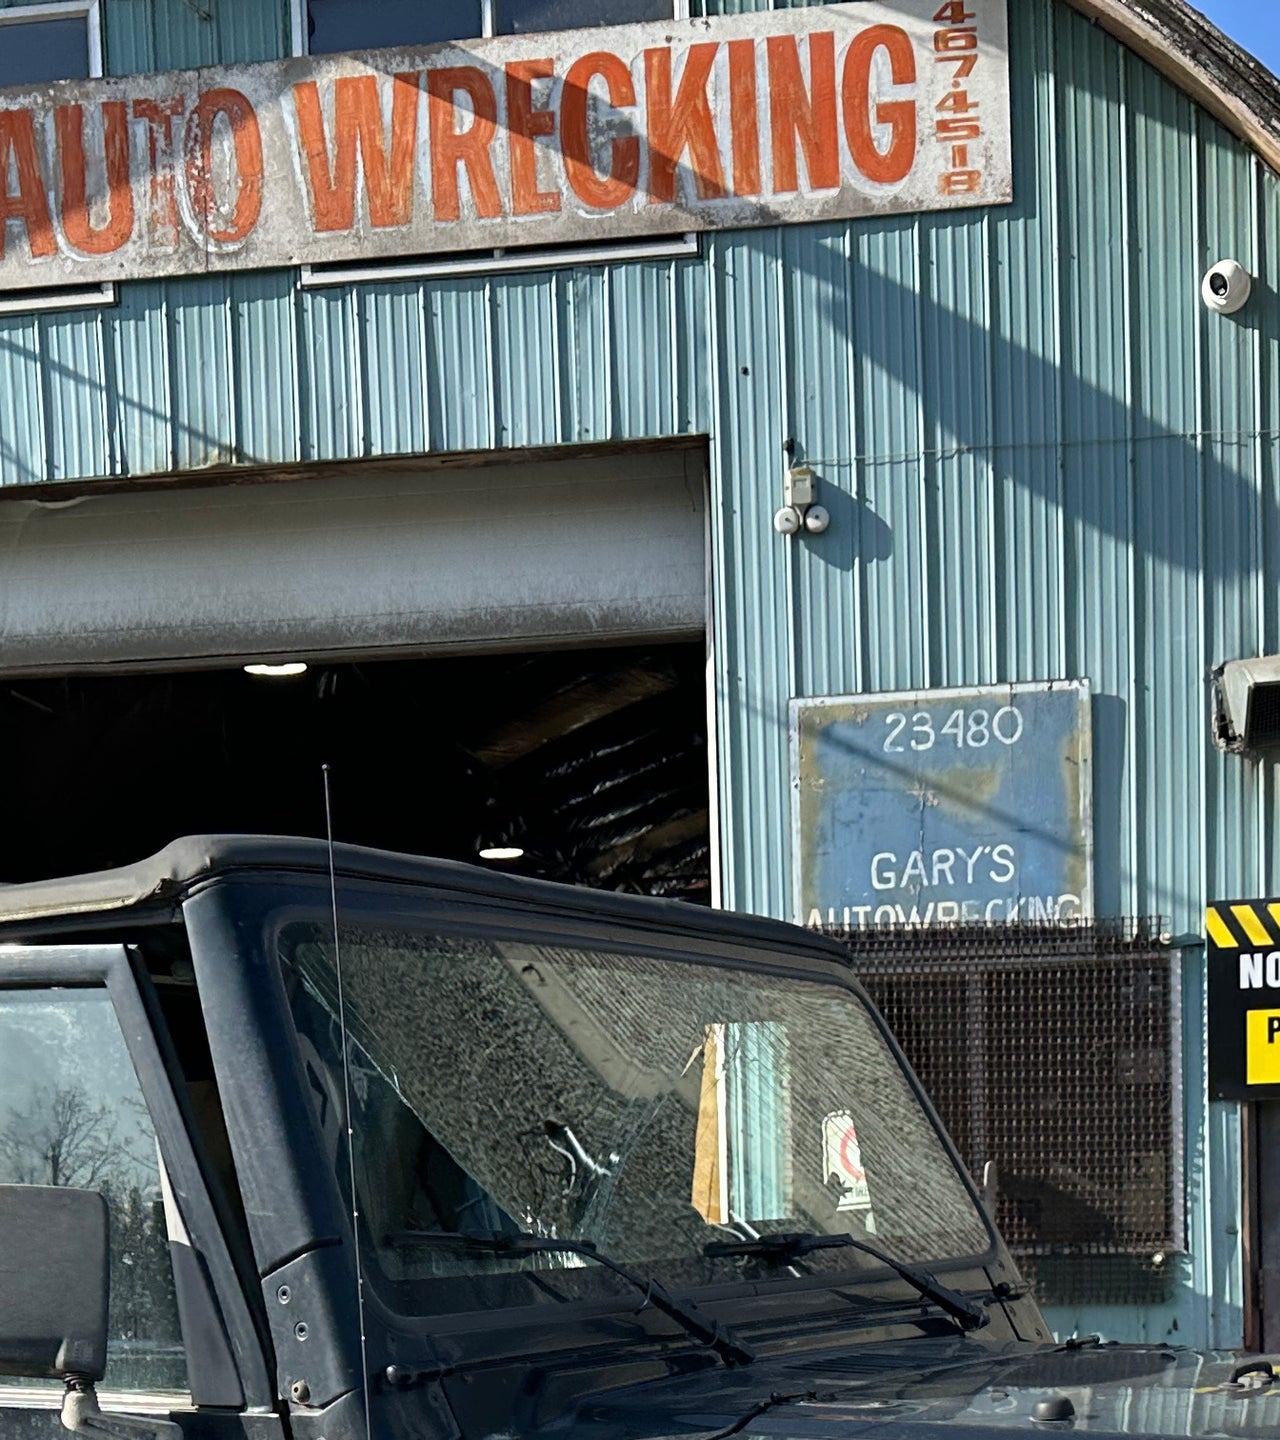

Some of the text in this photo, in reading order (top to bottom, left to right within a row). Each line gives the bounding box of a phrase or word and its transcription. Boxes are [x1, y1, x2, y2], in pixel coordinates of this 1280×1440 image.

[291, 23, 918, 232] WRECKING
[882, 705, 1025, 753] 23480
[869, 844, 1016, 891] GARY'S
